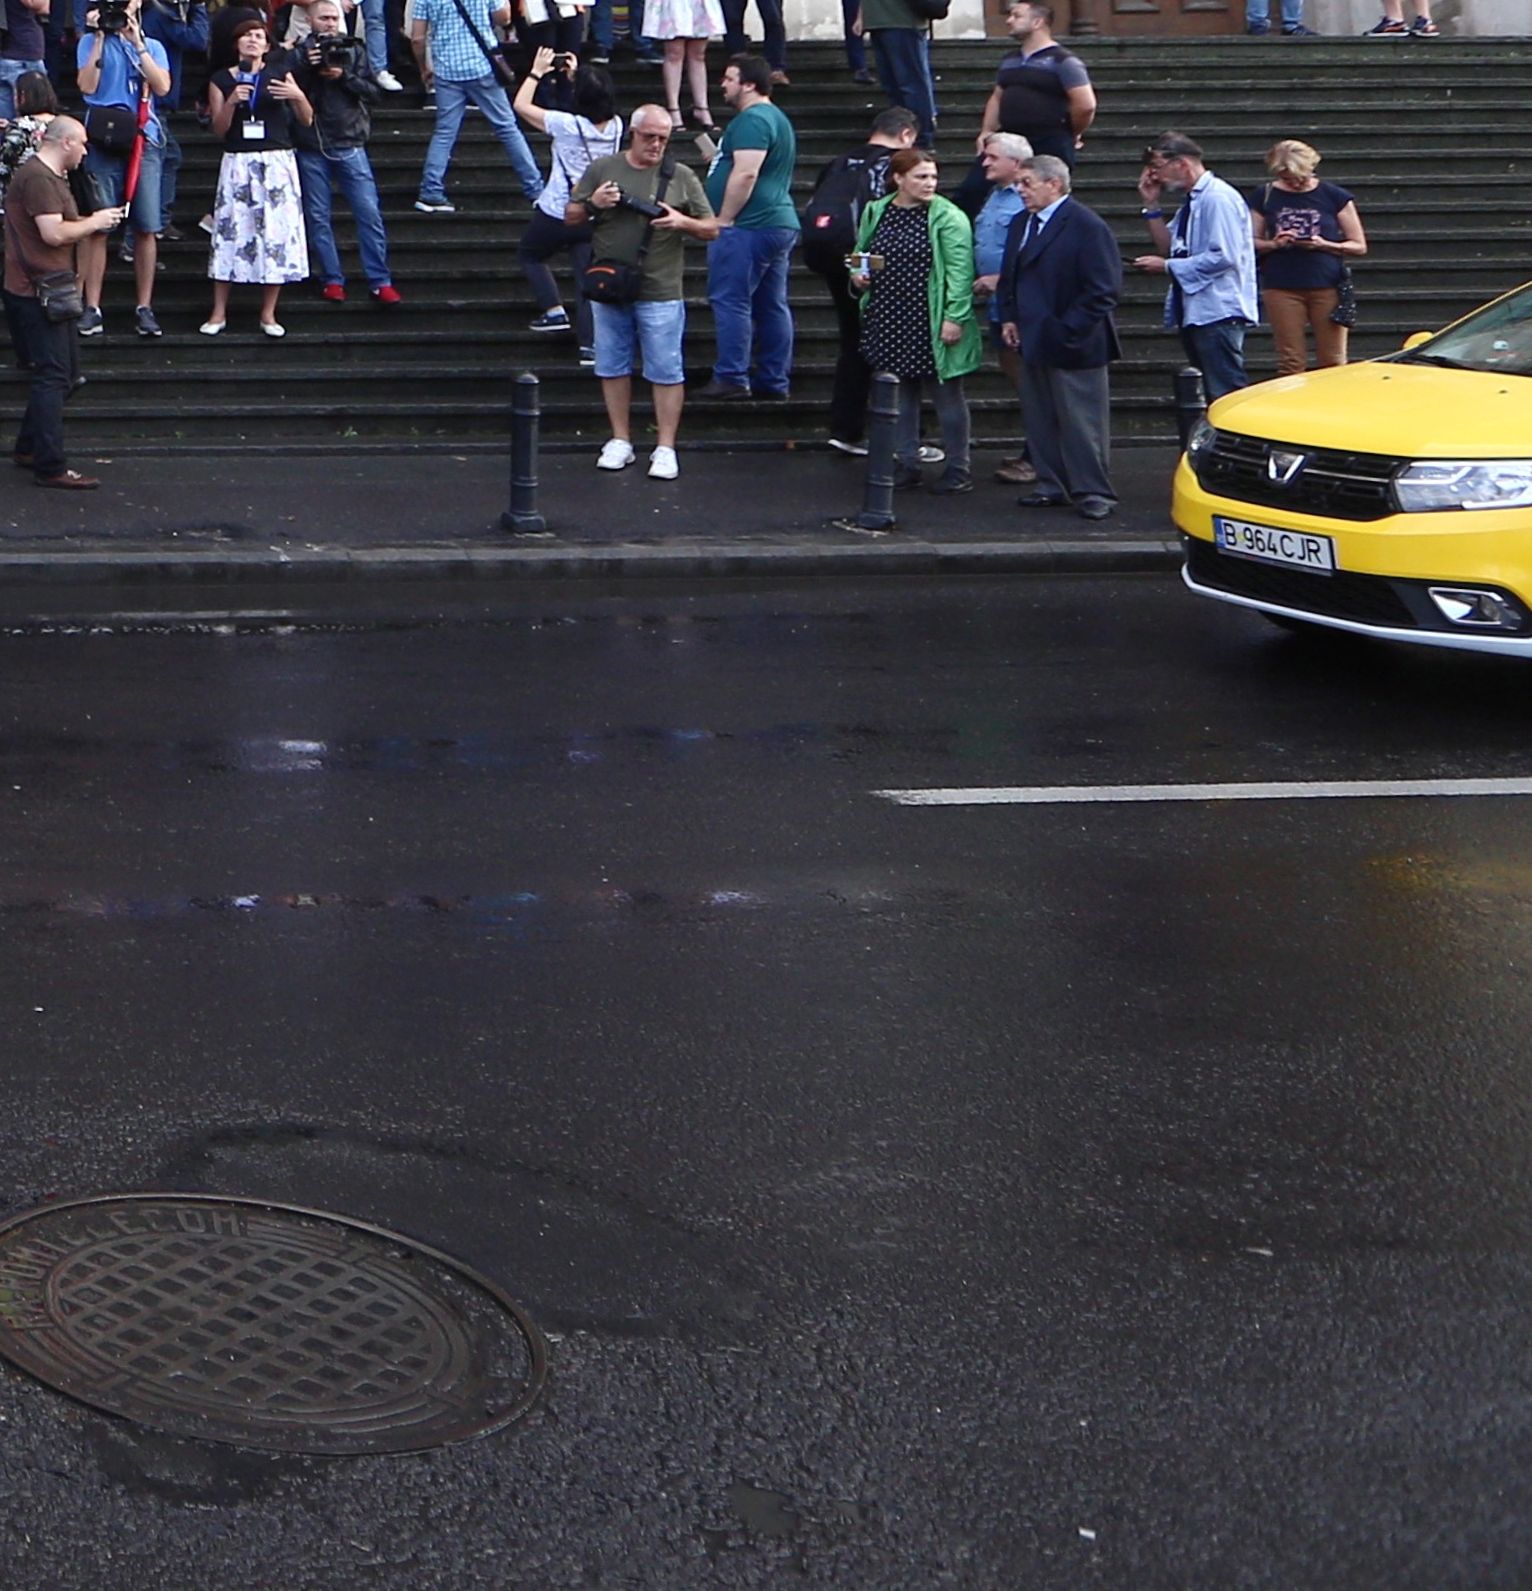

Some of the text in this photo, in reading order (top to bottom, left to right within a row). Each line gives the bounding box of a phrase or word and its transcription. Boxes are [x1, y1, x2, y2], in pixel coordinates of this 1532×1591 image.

[1223, 522, 1323, 564] B 964 CJR
